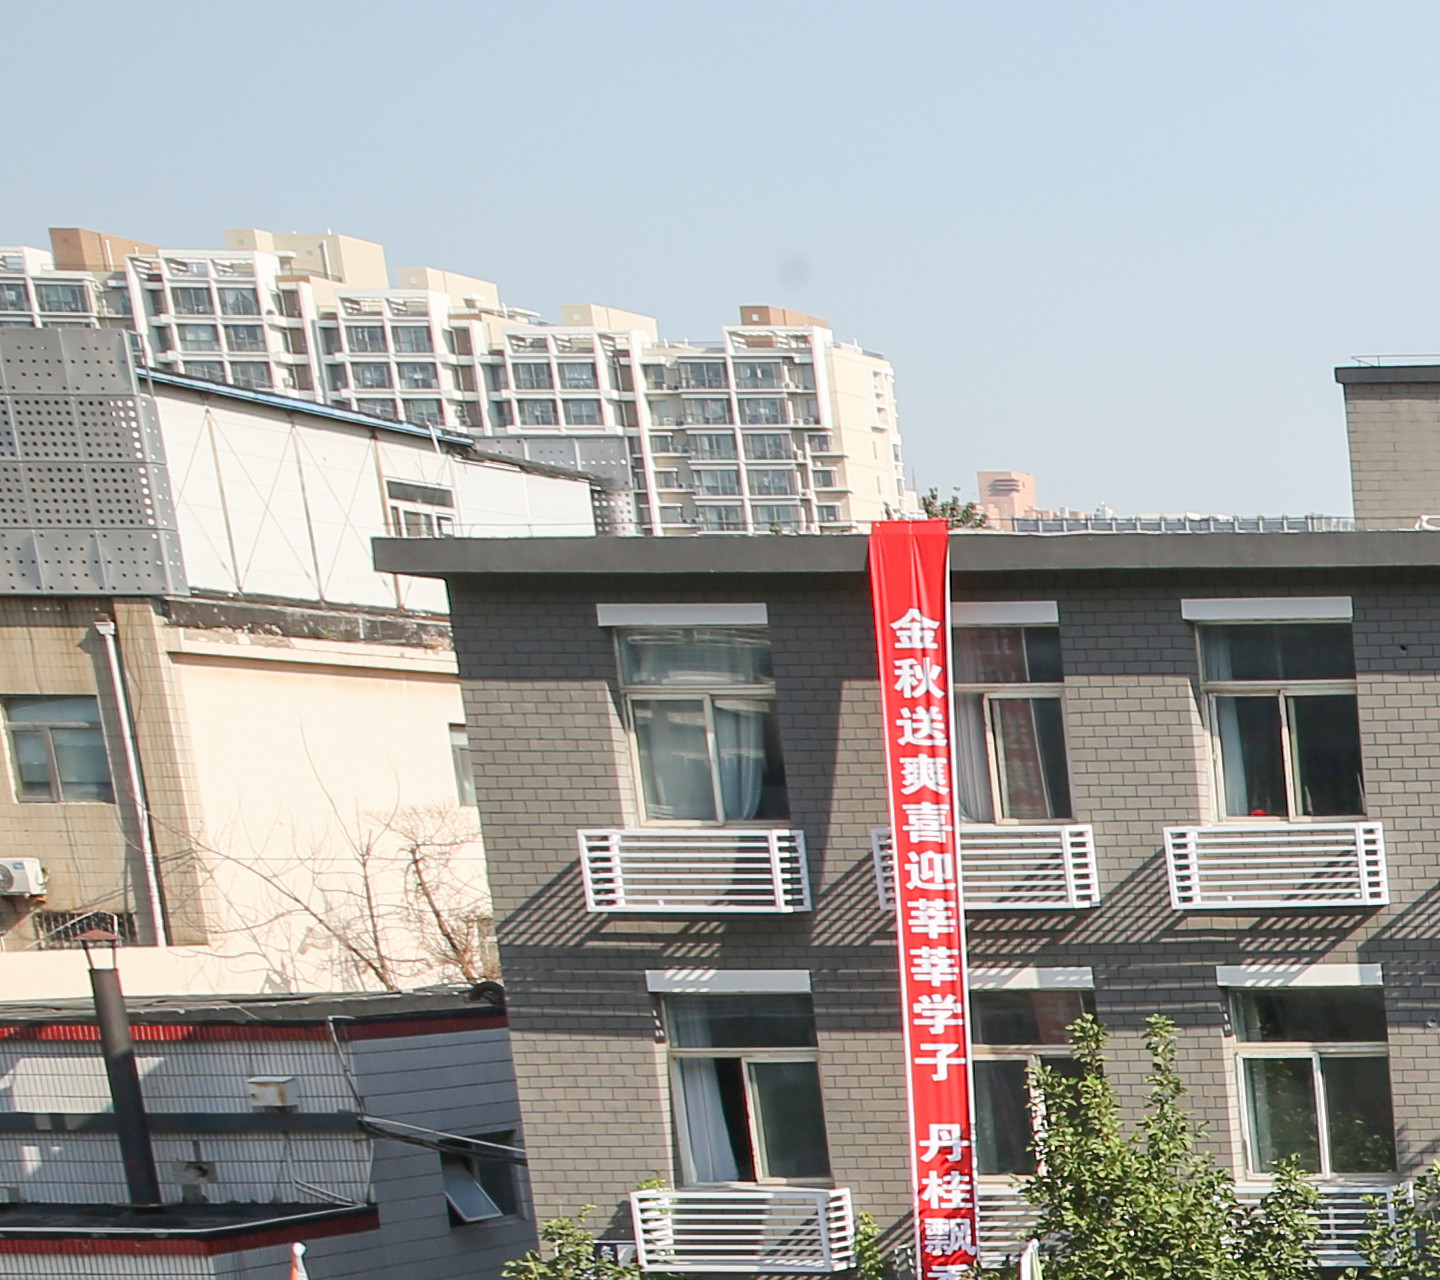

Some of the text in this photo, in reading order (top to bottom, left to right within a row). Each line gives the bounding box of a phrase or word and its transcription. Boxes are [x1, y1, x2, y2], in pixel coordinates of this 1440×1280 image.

[889, 606, 966, 1083] 金秋送爽喜迎莘莘学子
